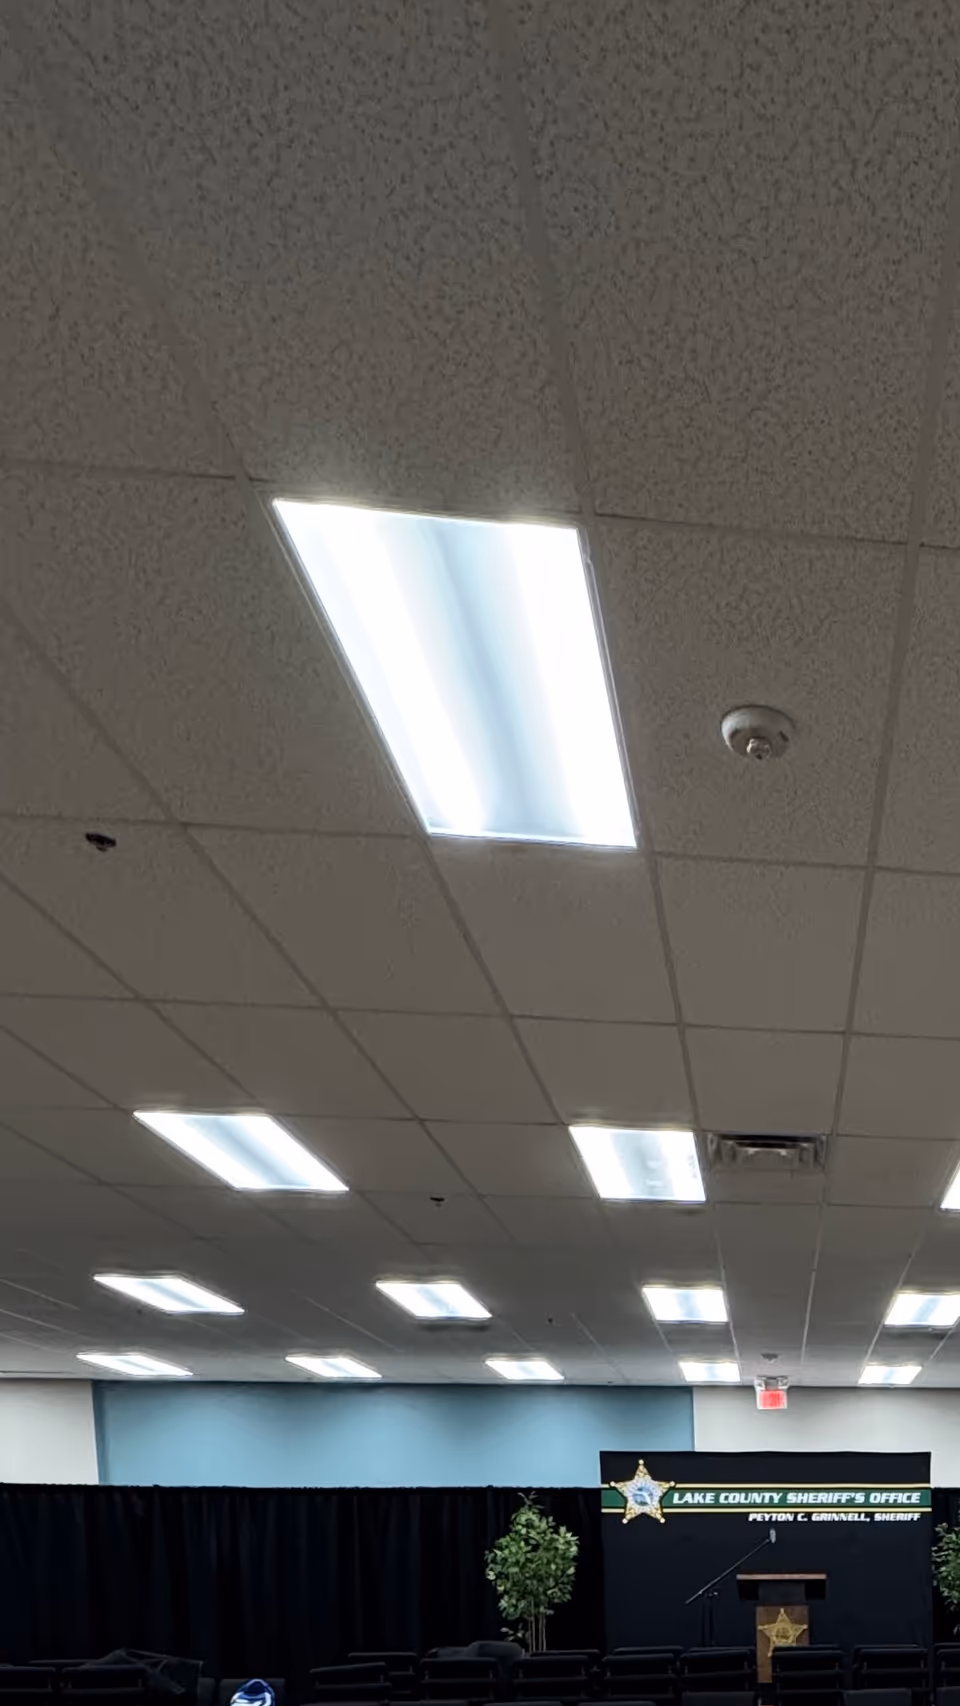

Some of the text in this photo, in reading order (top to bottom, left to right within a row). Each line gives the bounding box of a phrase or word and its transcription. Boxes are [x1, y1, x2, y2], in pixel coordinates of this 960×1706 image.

[673, 1492, 921, 1504] LAKE COUNTY SHERIFF'S OFFICE
[748, 1513, 921, 1523] PEYTON C. GRINNELL, SHERIFF
